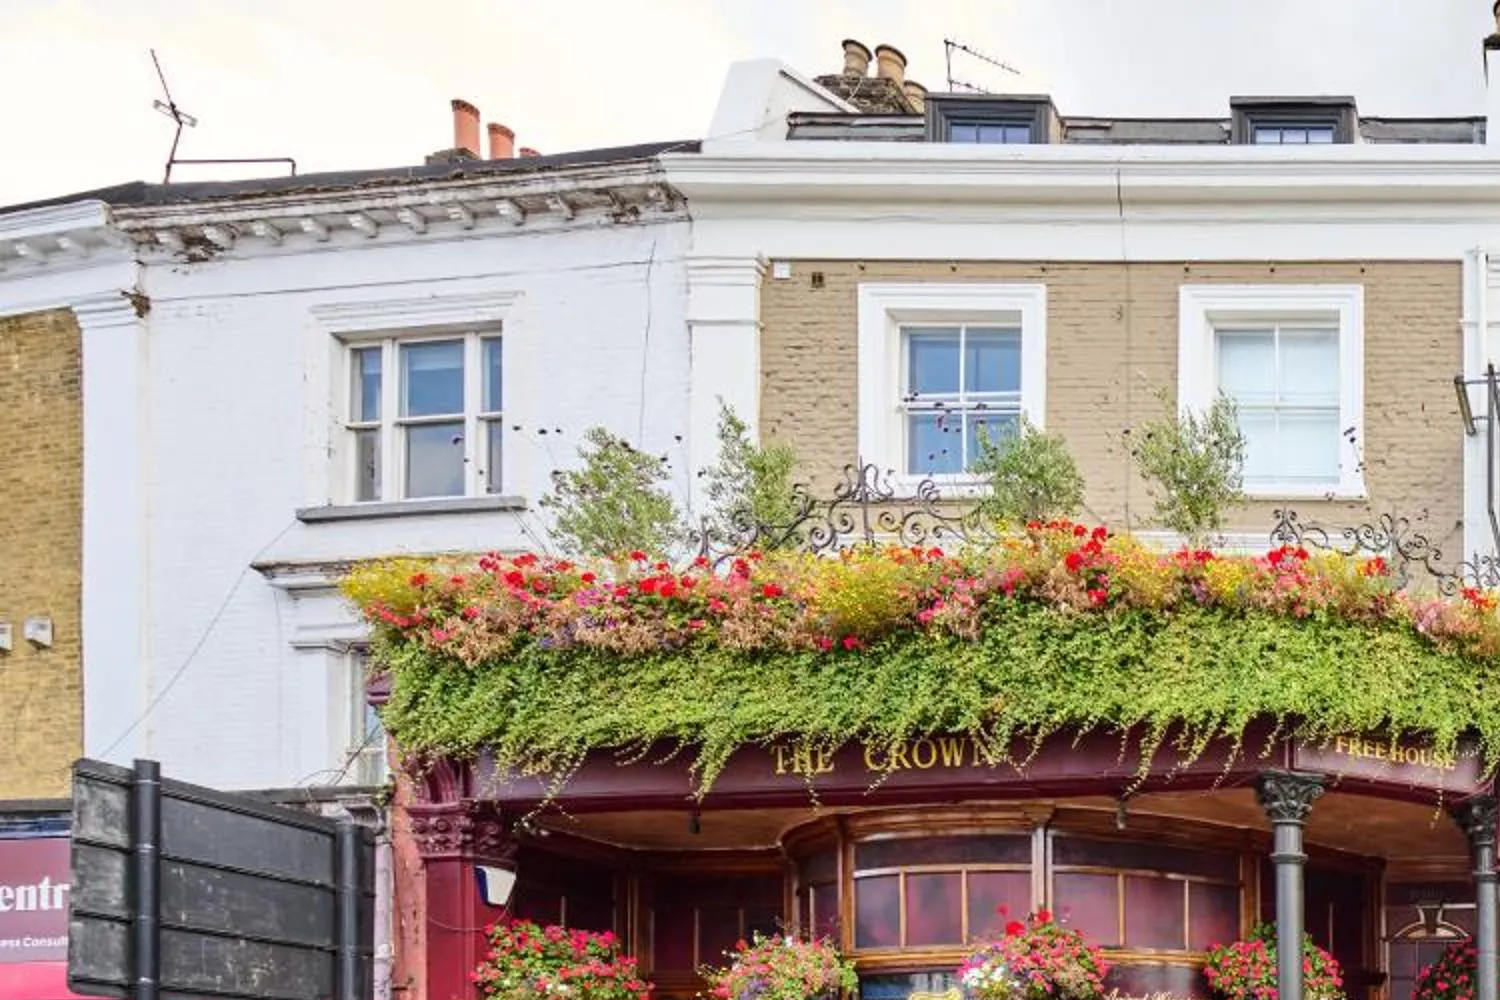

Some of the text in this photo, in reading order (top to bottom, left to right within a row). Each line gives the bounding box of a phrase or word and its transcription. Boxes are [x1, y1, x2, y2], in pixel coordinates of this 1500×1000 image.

[771, 737, 998, 775] THE CROWN
[1335, 735, 1457, 770] FREE HOUSE
